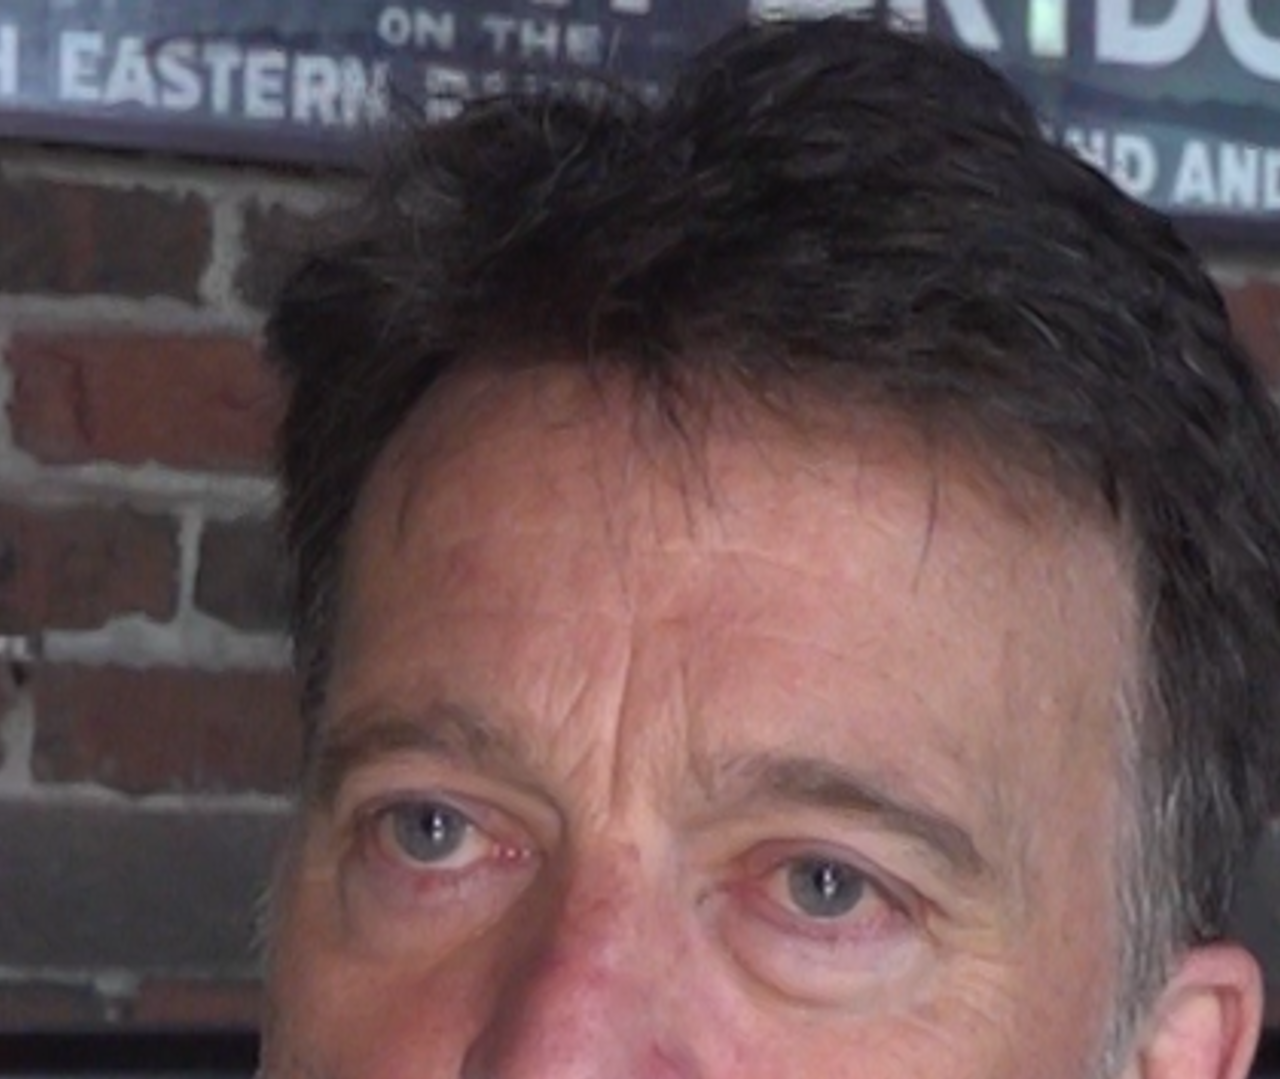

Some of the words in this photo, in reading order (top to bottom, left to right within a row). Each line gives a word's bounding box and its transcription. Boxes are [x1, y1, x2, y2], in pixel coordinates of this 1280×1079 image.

[376, 5, 456, 49] ON
[481, 12, 603, 65] THE
[59, 30, 392, 128] EASTERN
